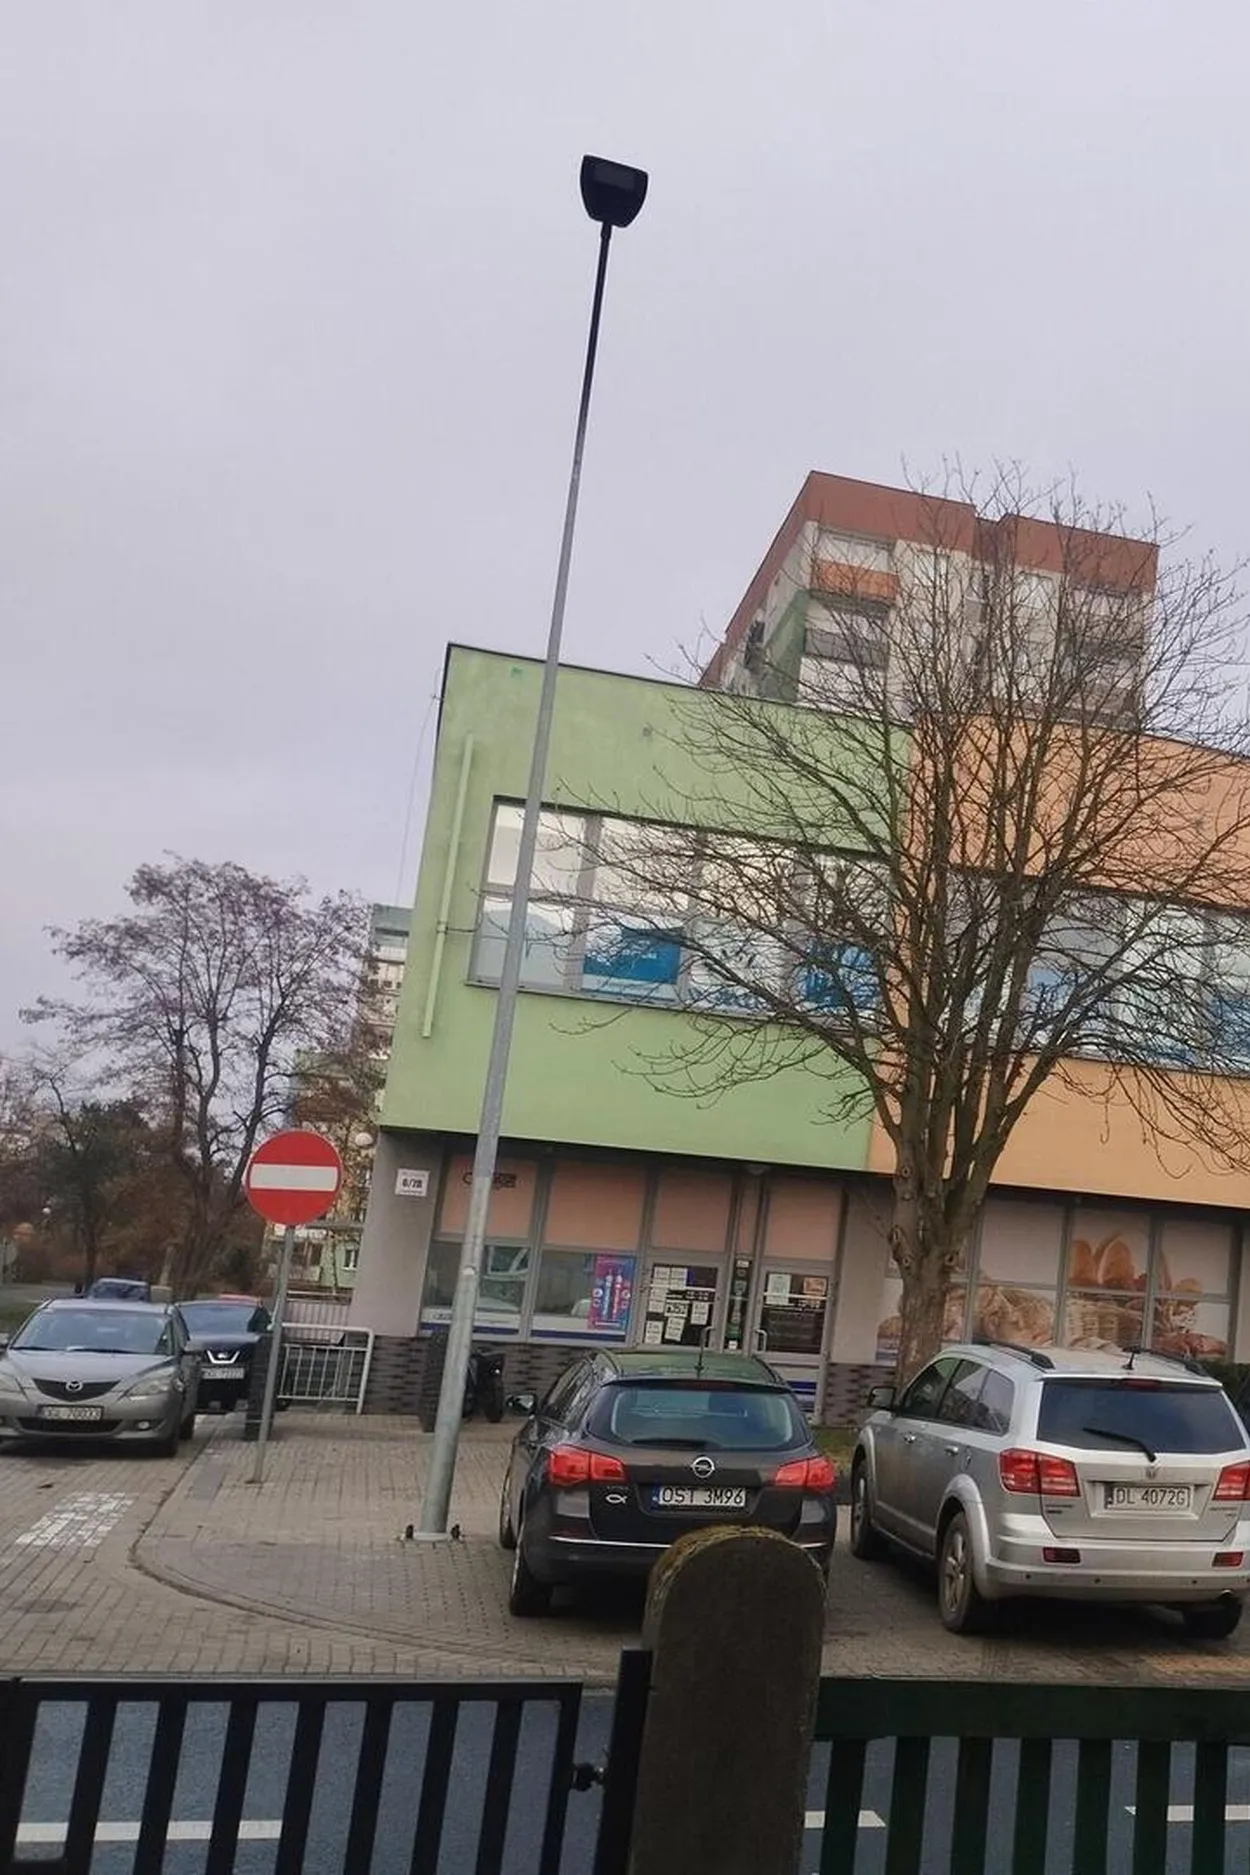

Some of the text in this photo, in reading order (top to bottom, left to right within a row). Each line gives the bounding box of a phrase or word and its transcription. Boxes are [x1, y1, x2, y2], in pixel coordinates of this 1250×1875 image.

[662, 1487, 744, 1505] OST 3M96
[1116, 1488, 1185, 1505] DL 4072G
